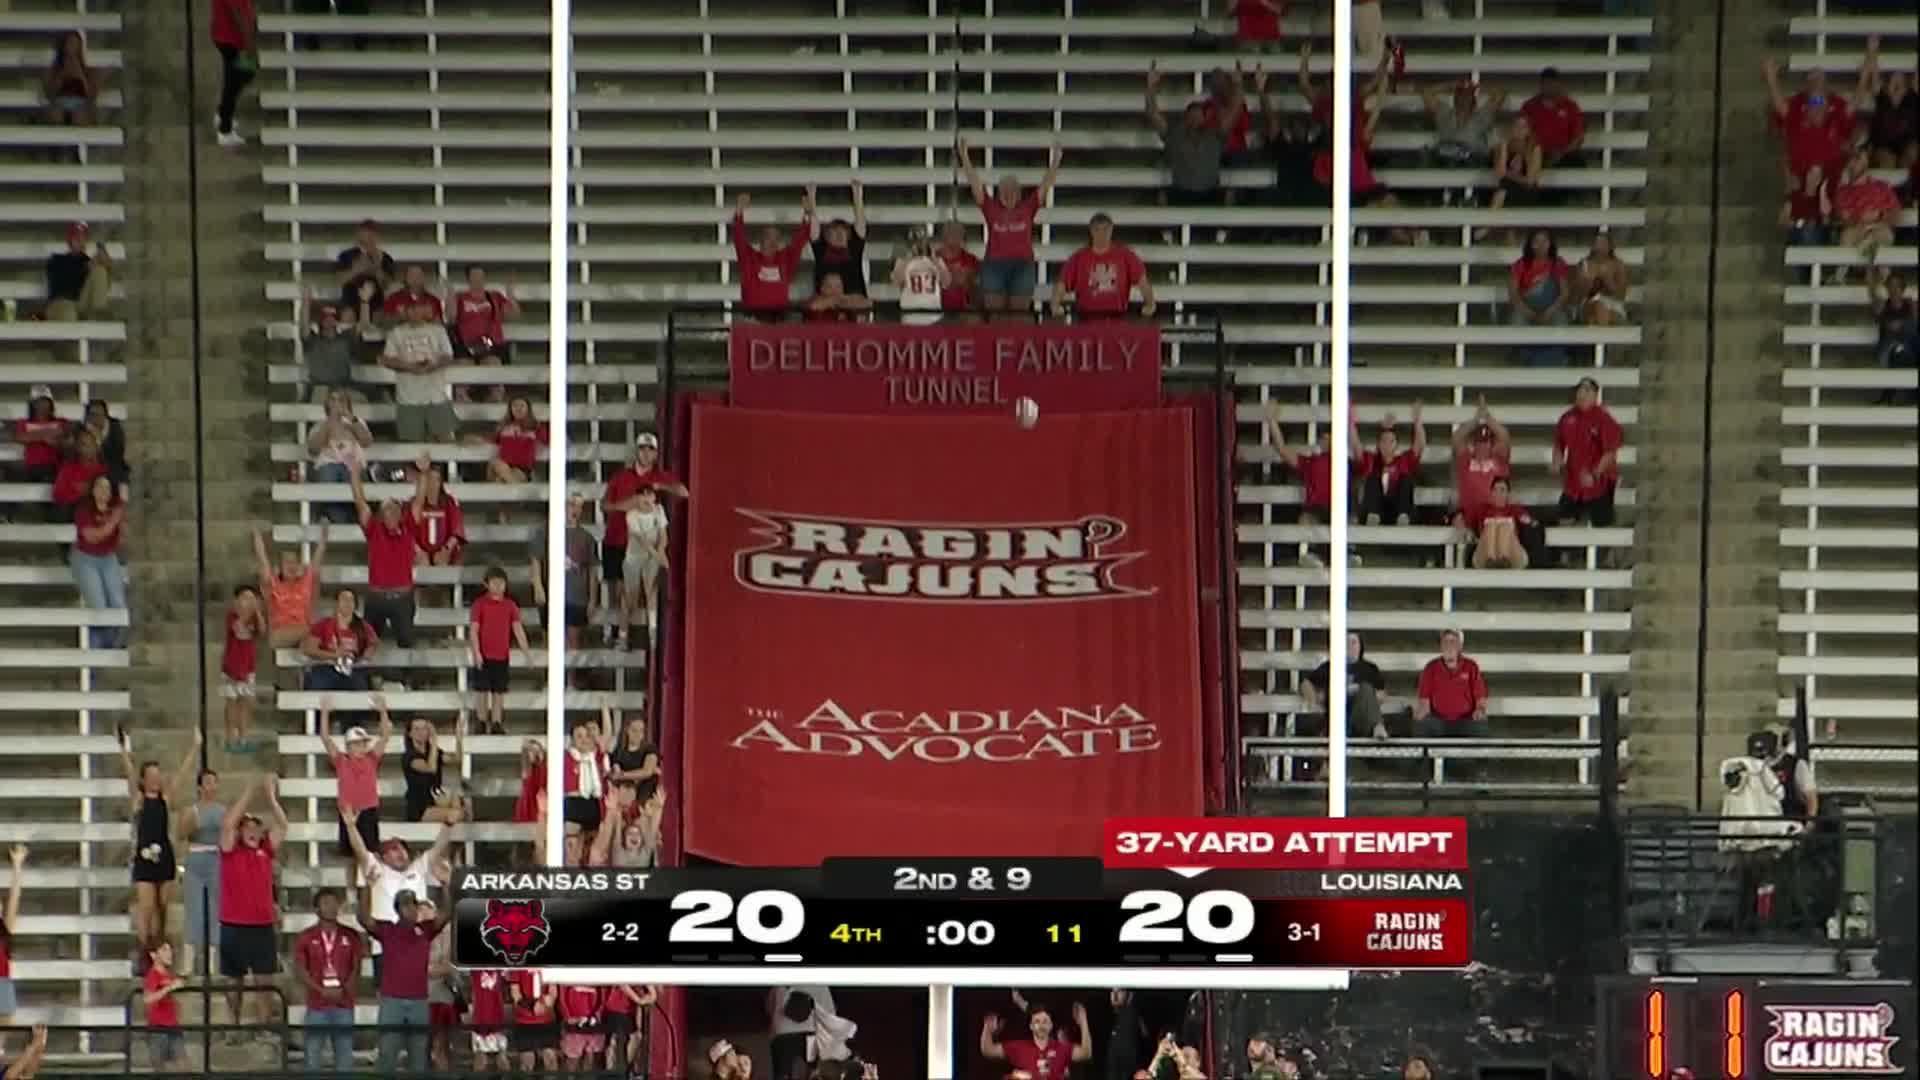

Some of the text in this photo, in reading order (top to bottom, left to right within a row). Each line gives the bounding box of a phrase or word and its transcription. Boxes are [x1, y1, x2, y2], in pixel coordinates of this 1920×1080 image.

[749, 338, 1140, 372] DELHOMME FAMILY
[886, 376, 1008, 405] TUNNEL
[750, 554, 1102, 597] CAJUNS
[794, 698, 1147, 733] ACADIANA
[729, 719, 1163, 762] ADVOCATE
[1770, 1041, 1886, 1068] CAJUNS
